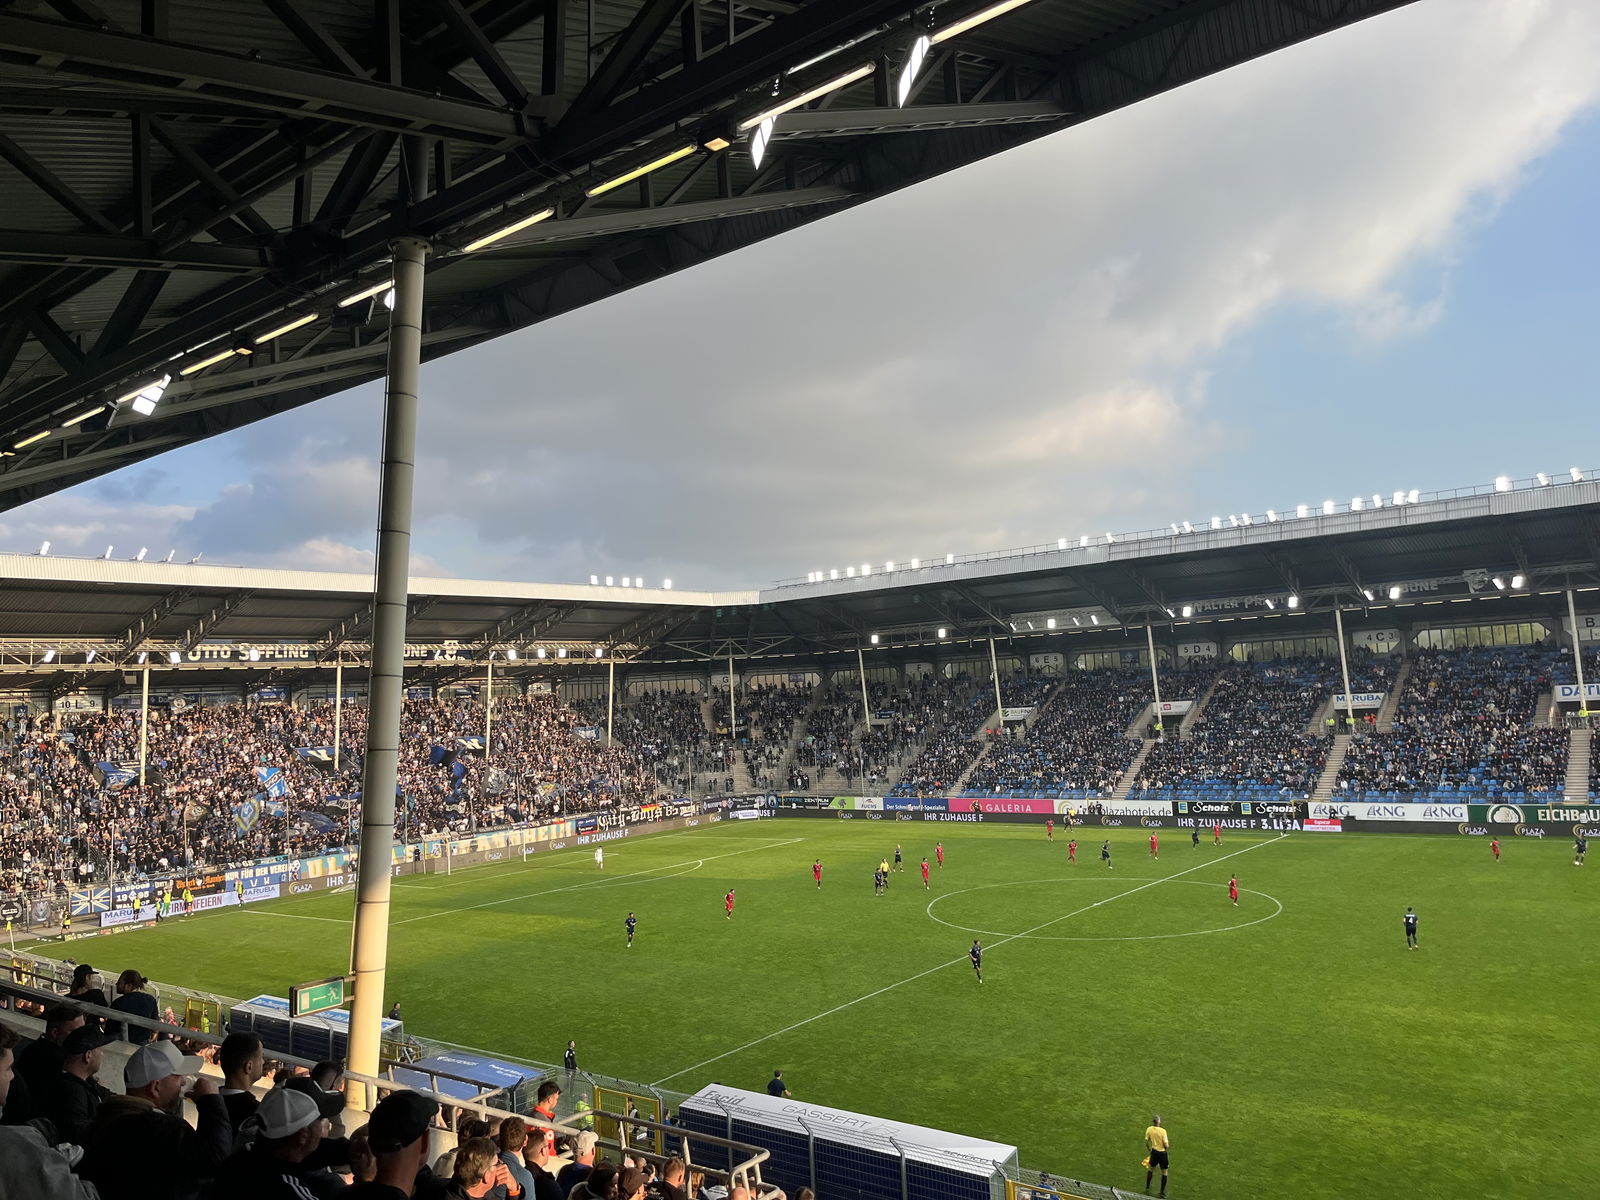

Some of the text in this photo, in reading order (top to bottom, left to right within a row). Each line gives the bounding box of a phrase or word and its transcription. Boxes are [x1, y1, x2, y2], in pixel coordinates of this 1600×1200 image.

[1585, 617, 1595, 627] B
[1376, 632, 1385, 641] C
[188, 643, 309, 661] OTTO SFFLING
[1193, 645, 1201, 653] D
[1044, 655, 1050, 664] E
[1336, 694, 1382, 702] MRUBA
[76, 700, 83, 709] L
[986, 804, 1033, 813] GALERIA
[924, 812, 937, 821] IHR
[940, 813, 976, 822] ZUHAUSE
[1178, 818, 1195, 828] IHR
[1521, 827, 1545, 835] PLAZA
[577, 835, 590, 845] IHR
[592, 830, 623, 843] ZUHAUSE
[255, 866, 269, 876] DEN
[327, 876, 344, 888] IHR
[104, 907, 146, 920] MARUA
[702, 1090, 746, 1106] Facid
[782, 1104, 872, 1128] GASSERT
